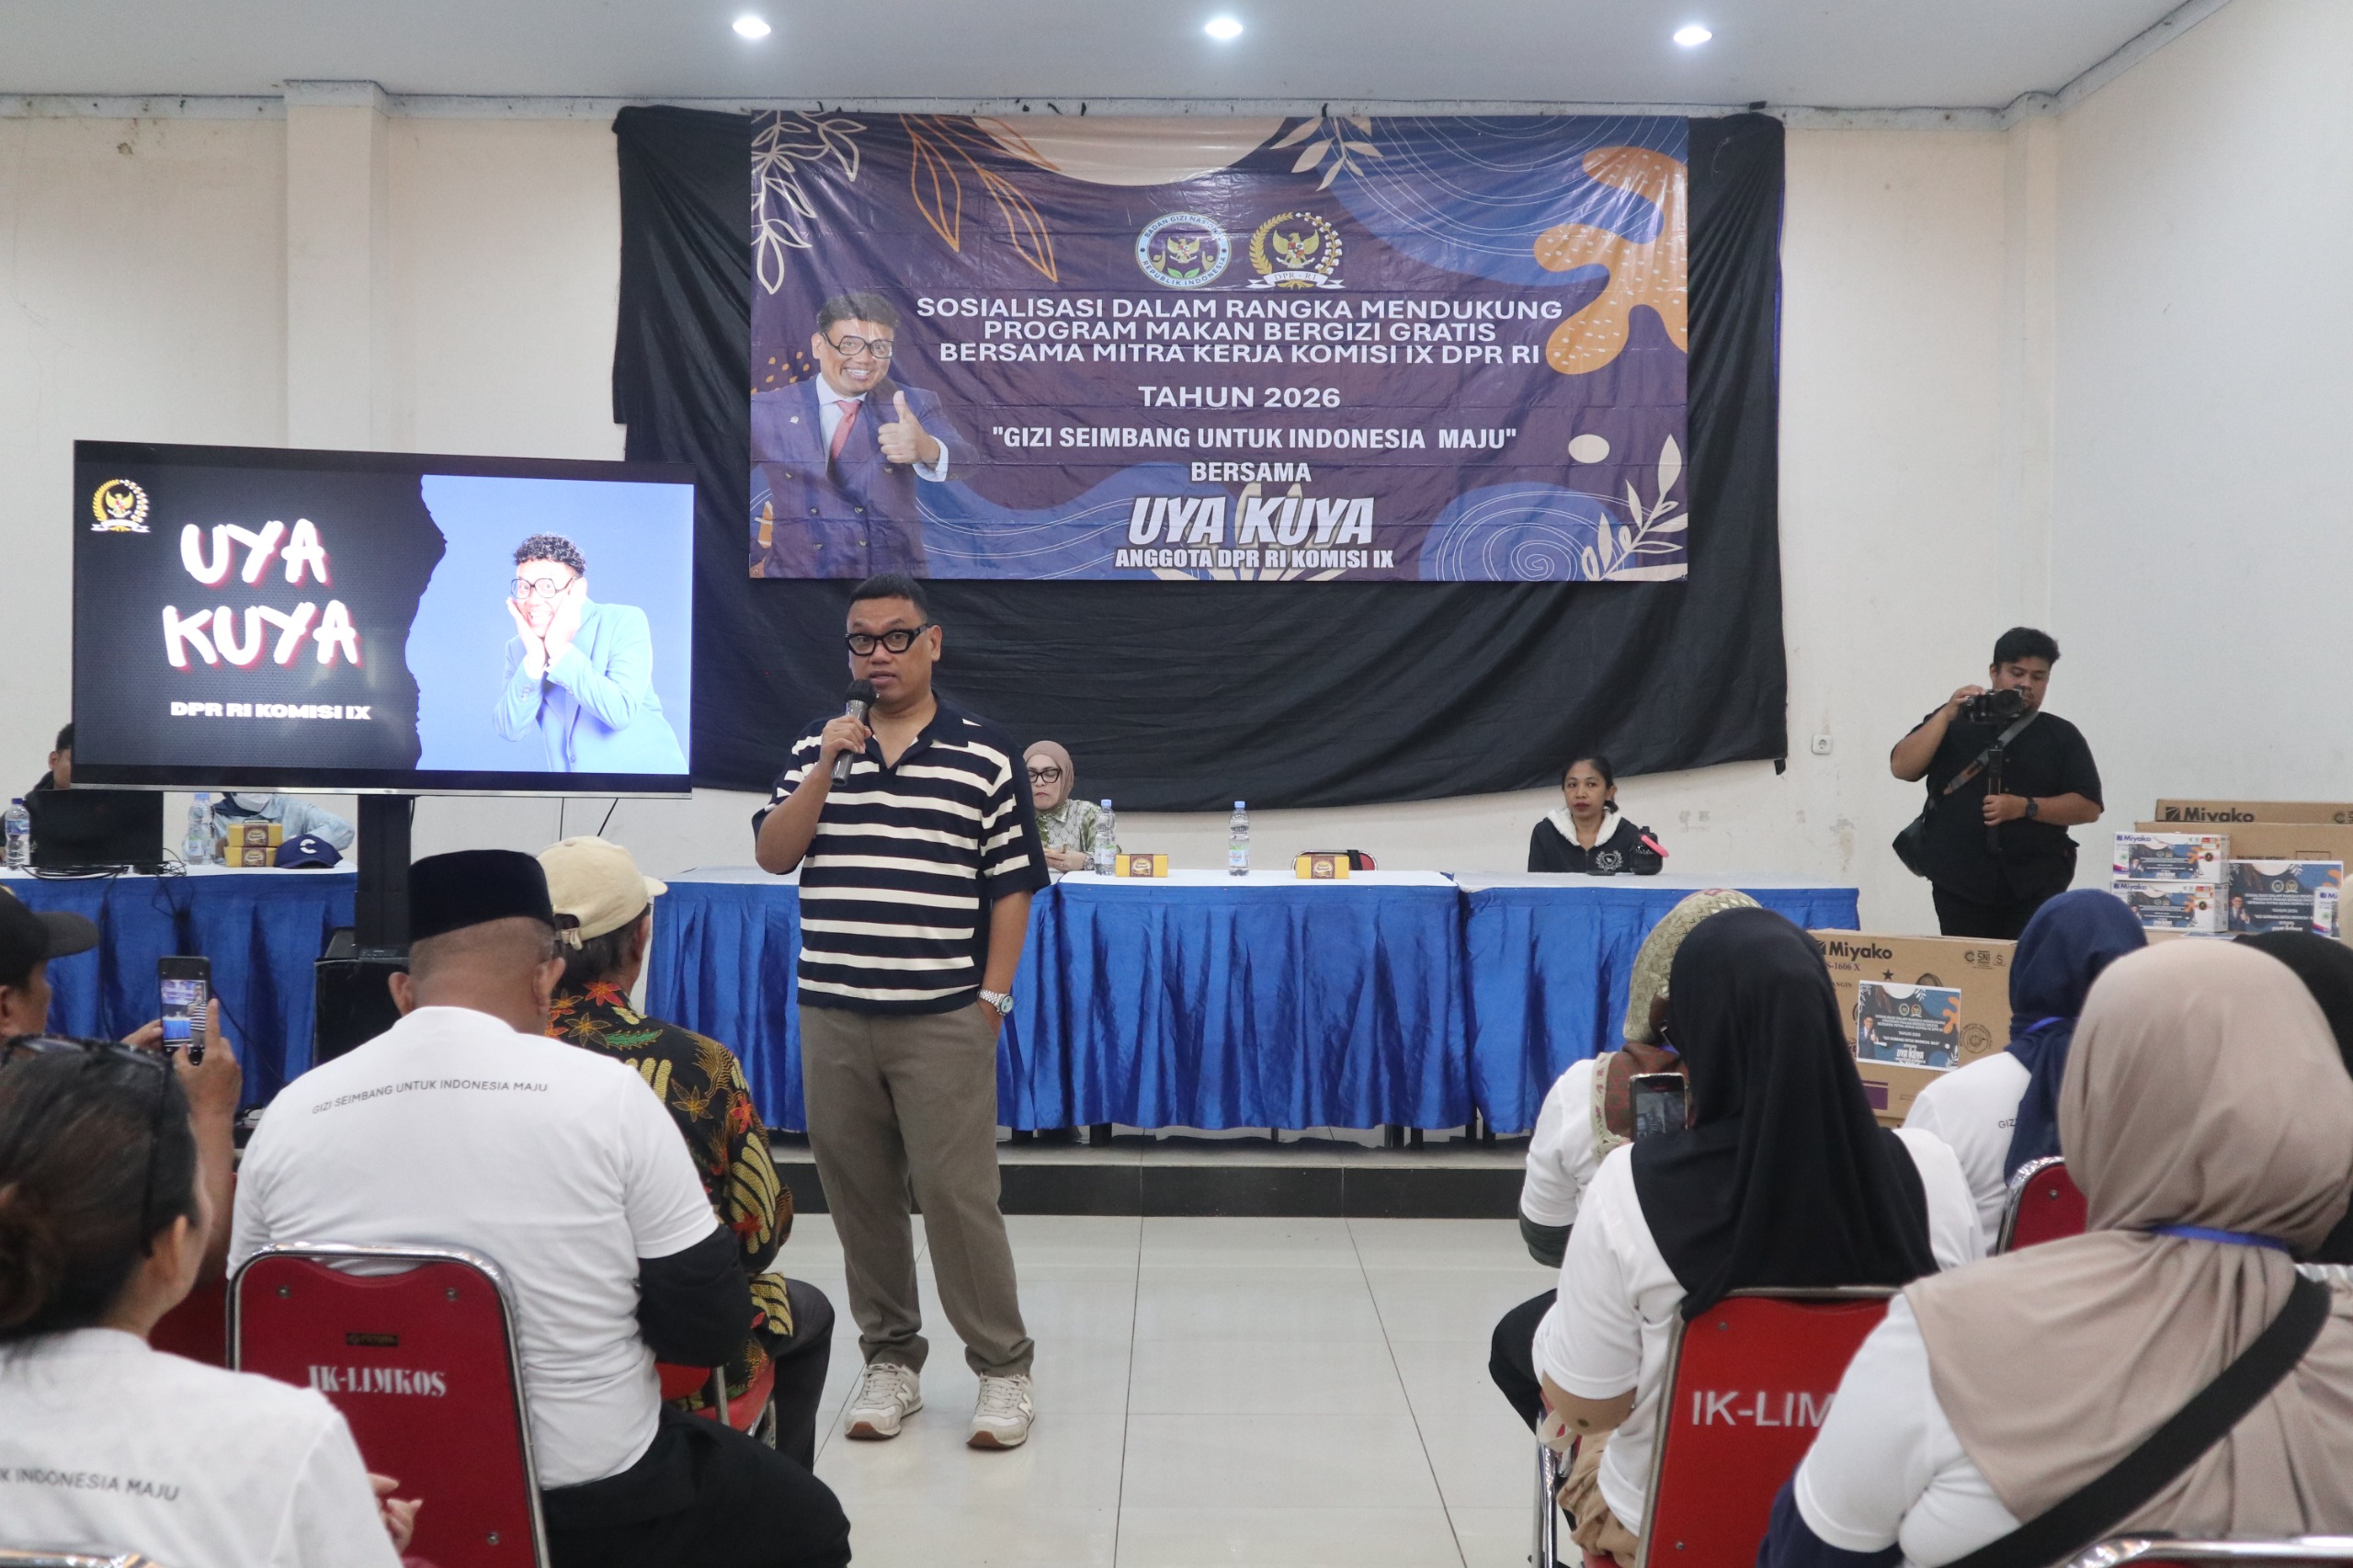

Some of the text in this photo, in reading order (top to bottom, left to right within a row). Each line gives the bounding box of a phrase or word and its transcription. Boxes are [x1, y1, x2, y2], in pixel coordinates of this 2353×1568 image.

[1144, 219, 1168, 238] BADAN
[1189, 216, 1222, 241] NASION
[1142, 257, 1226, 286] REPUBLIK INDONESIA
[1274, 272, 1294, 280] DPR
[916, 298, 1563, 320] SOSIALISASI DALAM RANGKA MENDUKUNG
[984, 321, 1496, 342] PROGRAM MAKAN BERGIZI GRATIS
[940, 343, 1540, 364] BERSAMA MITRA KERJA KOMISI IX DPR RI
[1138, 386, 1341, 408] TAHUN 2026
[993, 426, 1517, 449] "GIZI SEIMBANG UNTUK INDONESIA MAJU"
[1191, 461, 1312, 482] BERSAMA
[1128, 496, 1374, 546] UYA KUYA
[180, 518, 330, 586] UYA
[1115, 549, 1394, 568] ANGGOTA DPR RI KOMISI IX
[163, 599, 360, 671] KUYA
[171, 701, 371, 720] DPR RI KOMISI IX
[300, 838, 318, 855] C
[2123, 835, 2152, 843] Miyako
[2120, 882, 2147, 891] Miyako
[1829, 941, 1893, 961] Miyako
[1977, 952, 1990, 962] SNI
[1826, 962, 1860, 971] S-1606 X
[312, 1079, 548, 1115] GIZI SEIMBANG UNTUK INDONESIA MAJU
[1998, 1118, 2017, 1129] GIZ
[308, 1364, 447, 1398] IK-LIMKOS
[1692, 1390, 1837, 1427] IK-LIM
[16, 1469, 119, 1492] INDONESIA
[126, 1478, 181, 1502] MAJU
